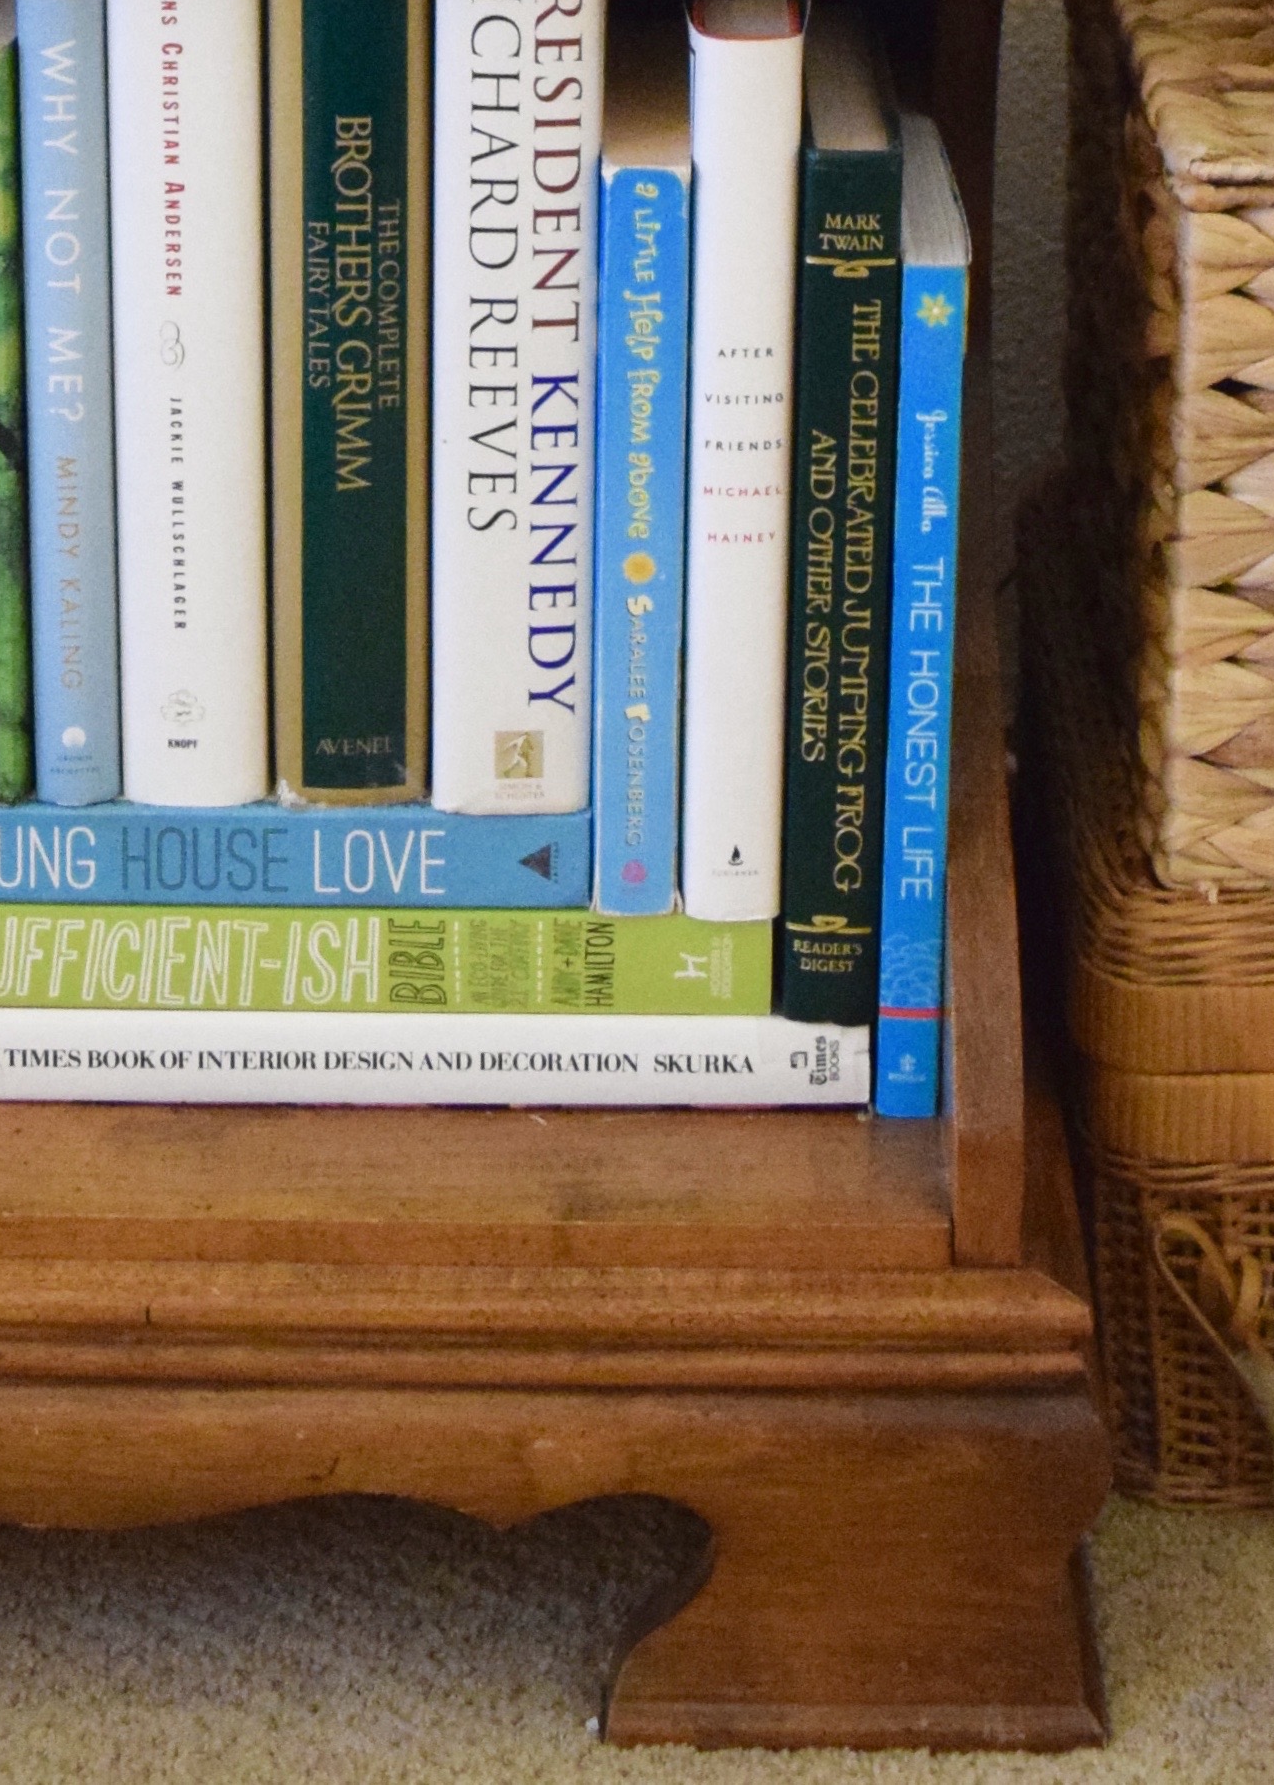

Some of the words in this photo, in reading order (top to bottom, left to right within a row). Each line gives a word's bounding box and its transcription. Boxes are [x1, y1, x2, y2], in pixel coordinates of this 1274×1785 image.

[41, 39, 78, 155] WHY
[161, 41, 184, 166] CHRISTIAN
[44, 188, 82, 296] NOT
[164, 181, 186, 297] ANDERSEN
[308, 221, 328, 304] FAIRY
[335, 115, 373, 330] BROTHERS
[379, 203, 400, 254] THE
[818, 233, 884, 252] TWAIN
[824, 212, 880, 231] MARK
[308, 307, 330, 391] TALES
[380, 261, 399, 409] COMPLETE
[717, 347, 774, 358] AFTER
[851, 298, 882, 363] THE
[47, 327, 85, 423] ME?
[466, 296, 520, 535] REEVES
[704, 391, 785, 405] VISITING
[170, 397, 184, 465] JACKIE
[335, 340, 373, 495] GRIMM
[704, 438, 783, 451] FRIENDS
[916, 410, 948, 480] Jessica
[703, 485, 783, 497] MICHAEL
[809, 428, 838, 500] AND
[845, 370, 879, 595] CELEBRATED
[55, 455, 81, 559] MINDY
[528, 374, 581, 717] KENNEDY
[707, 532, 775, 543] HAINEY
[920, 485, 948, 535] Alba
[172, 479, 188, 631] WULLSCHLAGER
[805, 506, 836, 616] OTHER
[909, 556, 944, 632] THE
[59, 578, 84, 691] KALING
[626, 594, 654, 699] SARALEE
[801, 620, 831, 763] STORIES
[836, 598, 872, 779] JUMPING
[167, 738, 199, 750] KNOPF
[316, 736, 398, 756] AVENEL
[903, 650, 941, 811] HONEST
[121, 826, 289, 894] HOUSE
[312, 829, 447, 896] LOVE
[832, 783, 865, 894] FROG
[900, 826, 934, 902] LIFE
[387, 917, 449, 1006] BIBLE
[584, 921, 616, 1008] HAMILTON
[792, 938, 863, 956] READER'S
[800, 957, 854, 972] DIGEST
[3, 1047, 82, 1069] TIMES
[87, 1049, 155, 1070] BOOK
[160, 1049, 194, 1070] OF
[197, 1050, 317, 1070] INTERIOR
[325, 1050, 414, 1072] DESIGN
[420, 1051, 473, 1072] AND
[479, 1051, 640, 1073] DECORATION
[653, 1053, 754, 1074] SKURKA
[829, 1039, 841, 1083] BOOKS
